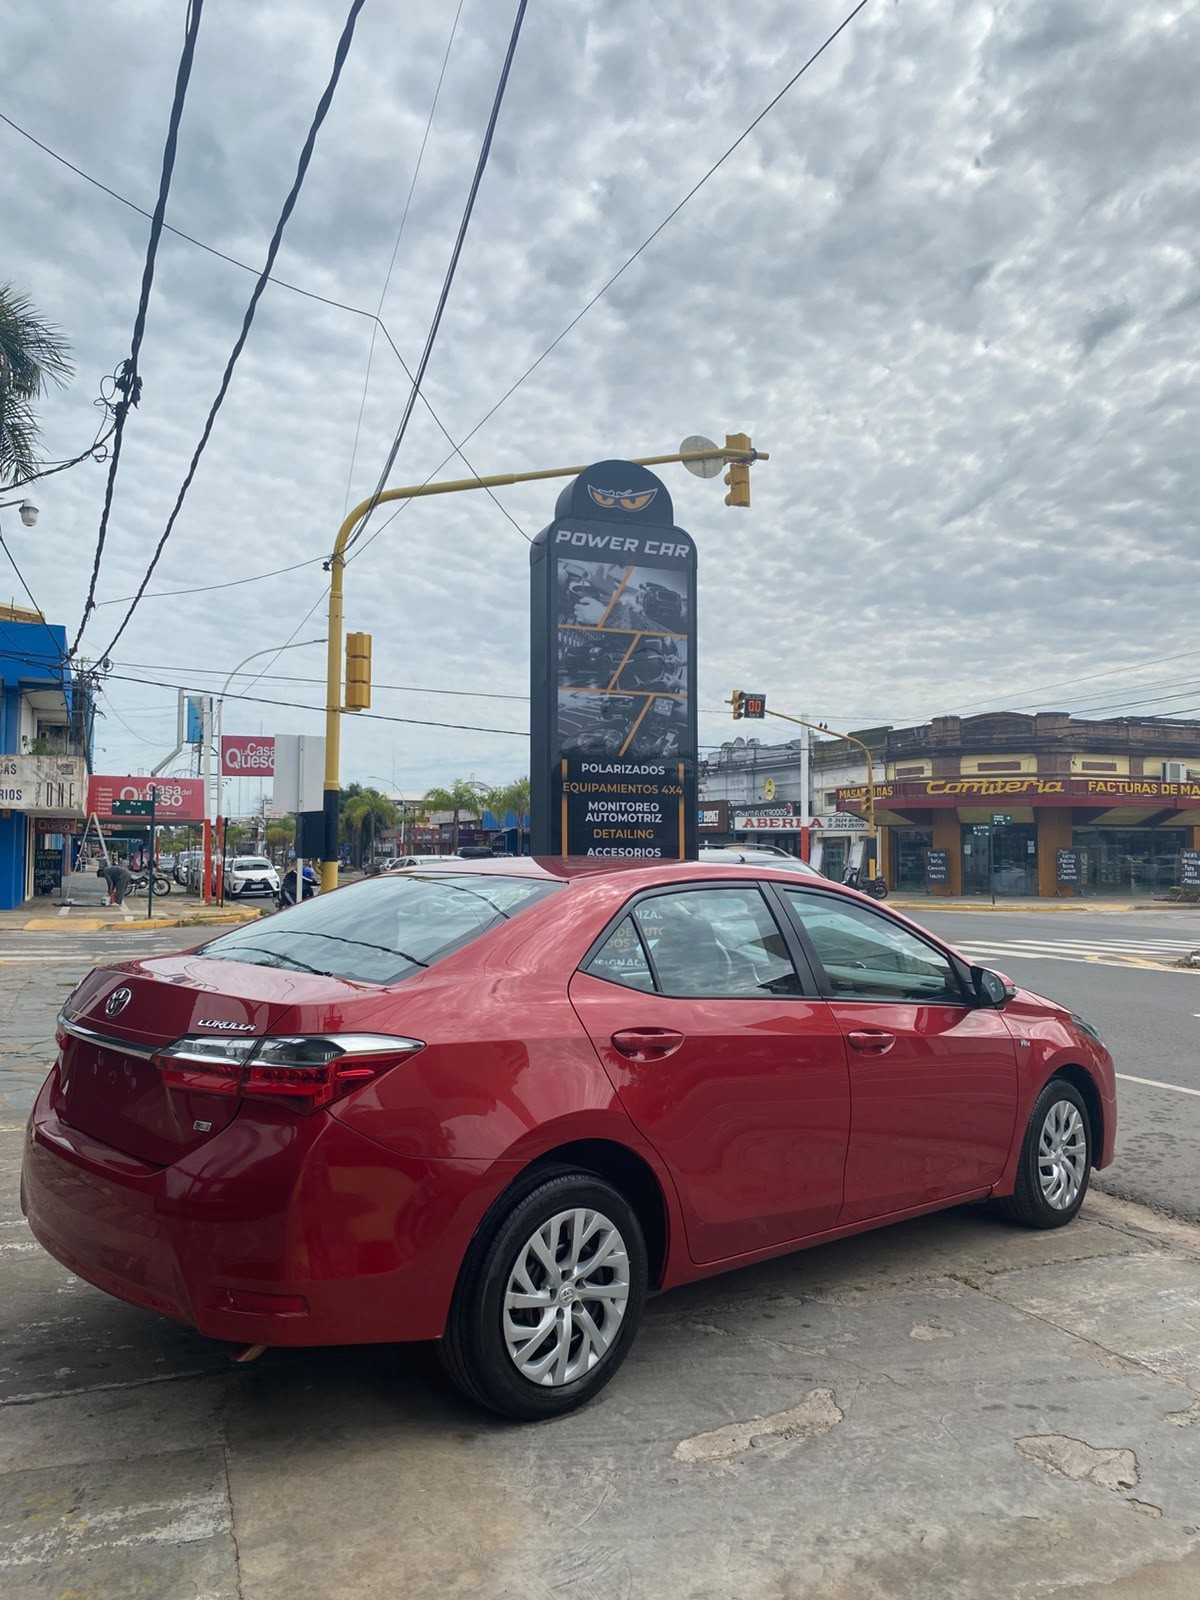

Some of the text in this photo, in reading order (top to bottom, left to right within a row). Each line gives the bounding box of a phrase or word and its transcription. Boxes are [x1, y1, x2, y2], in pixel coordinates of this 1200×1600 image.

[555, 530, 690, 558] POWER CAR
[581, 763, 665, 775] POLARIZADOS
[562, 782, 683, 795] EQUIPAMIENTOS 4X4
[1088, 781, 1158, 794] FACTURAS
[1161, 784, 1178, 794] DE
[120, 786, 183, 807] Quso
[588, 801, 660, 812] MONITOREO
[585, 812, 663, 823] AUTOMOTRIZ
[593, 829, 654, 839] DETAILING
[586, 847, 662, 858] ACCESORIOS
